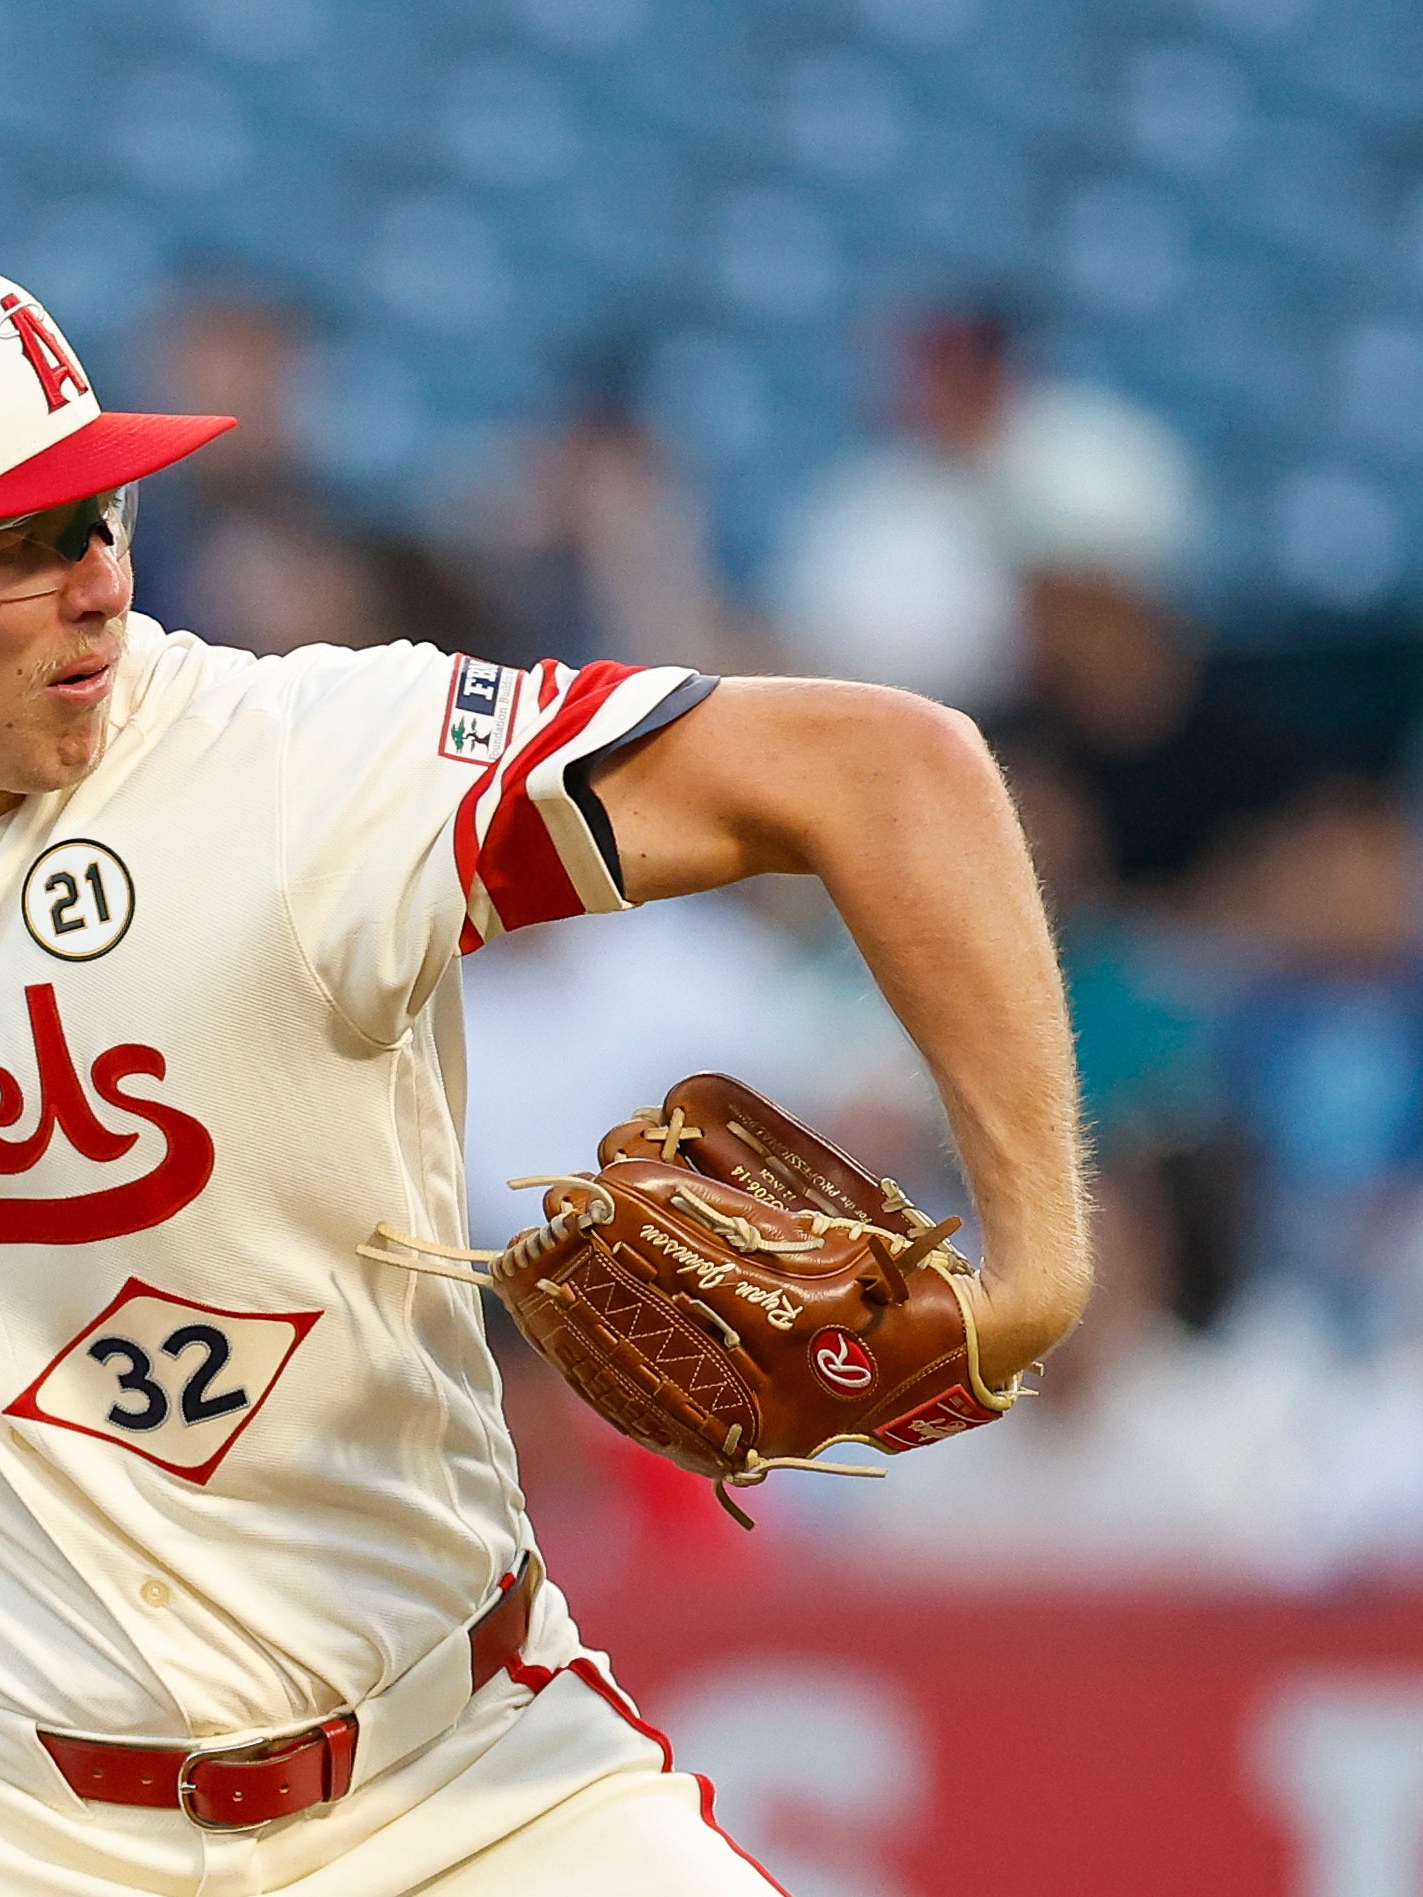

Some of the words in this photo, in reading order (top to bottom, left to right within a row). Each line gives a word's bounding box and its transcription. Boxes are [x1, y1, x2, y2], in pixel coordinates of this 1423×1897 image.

[488, 706, 508, 761] Foundation
[43, 861, 112, 937] 21
[840, 1195, 856, 1209] the
[639, 1224, 736, 1290] Johnson
[734, 1281, 804, 1331] Ryan
[87, 1322, 251, 1434] 32
